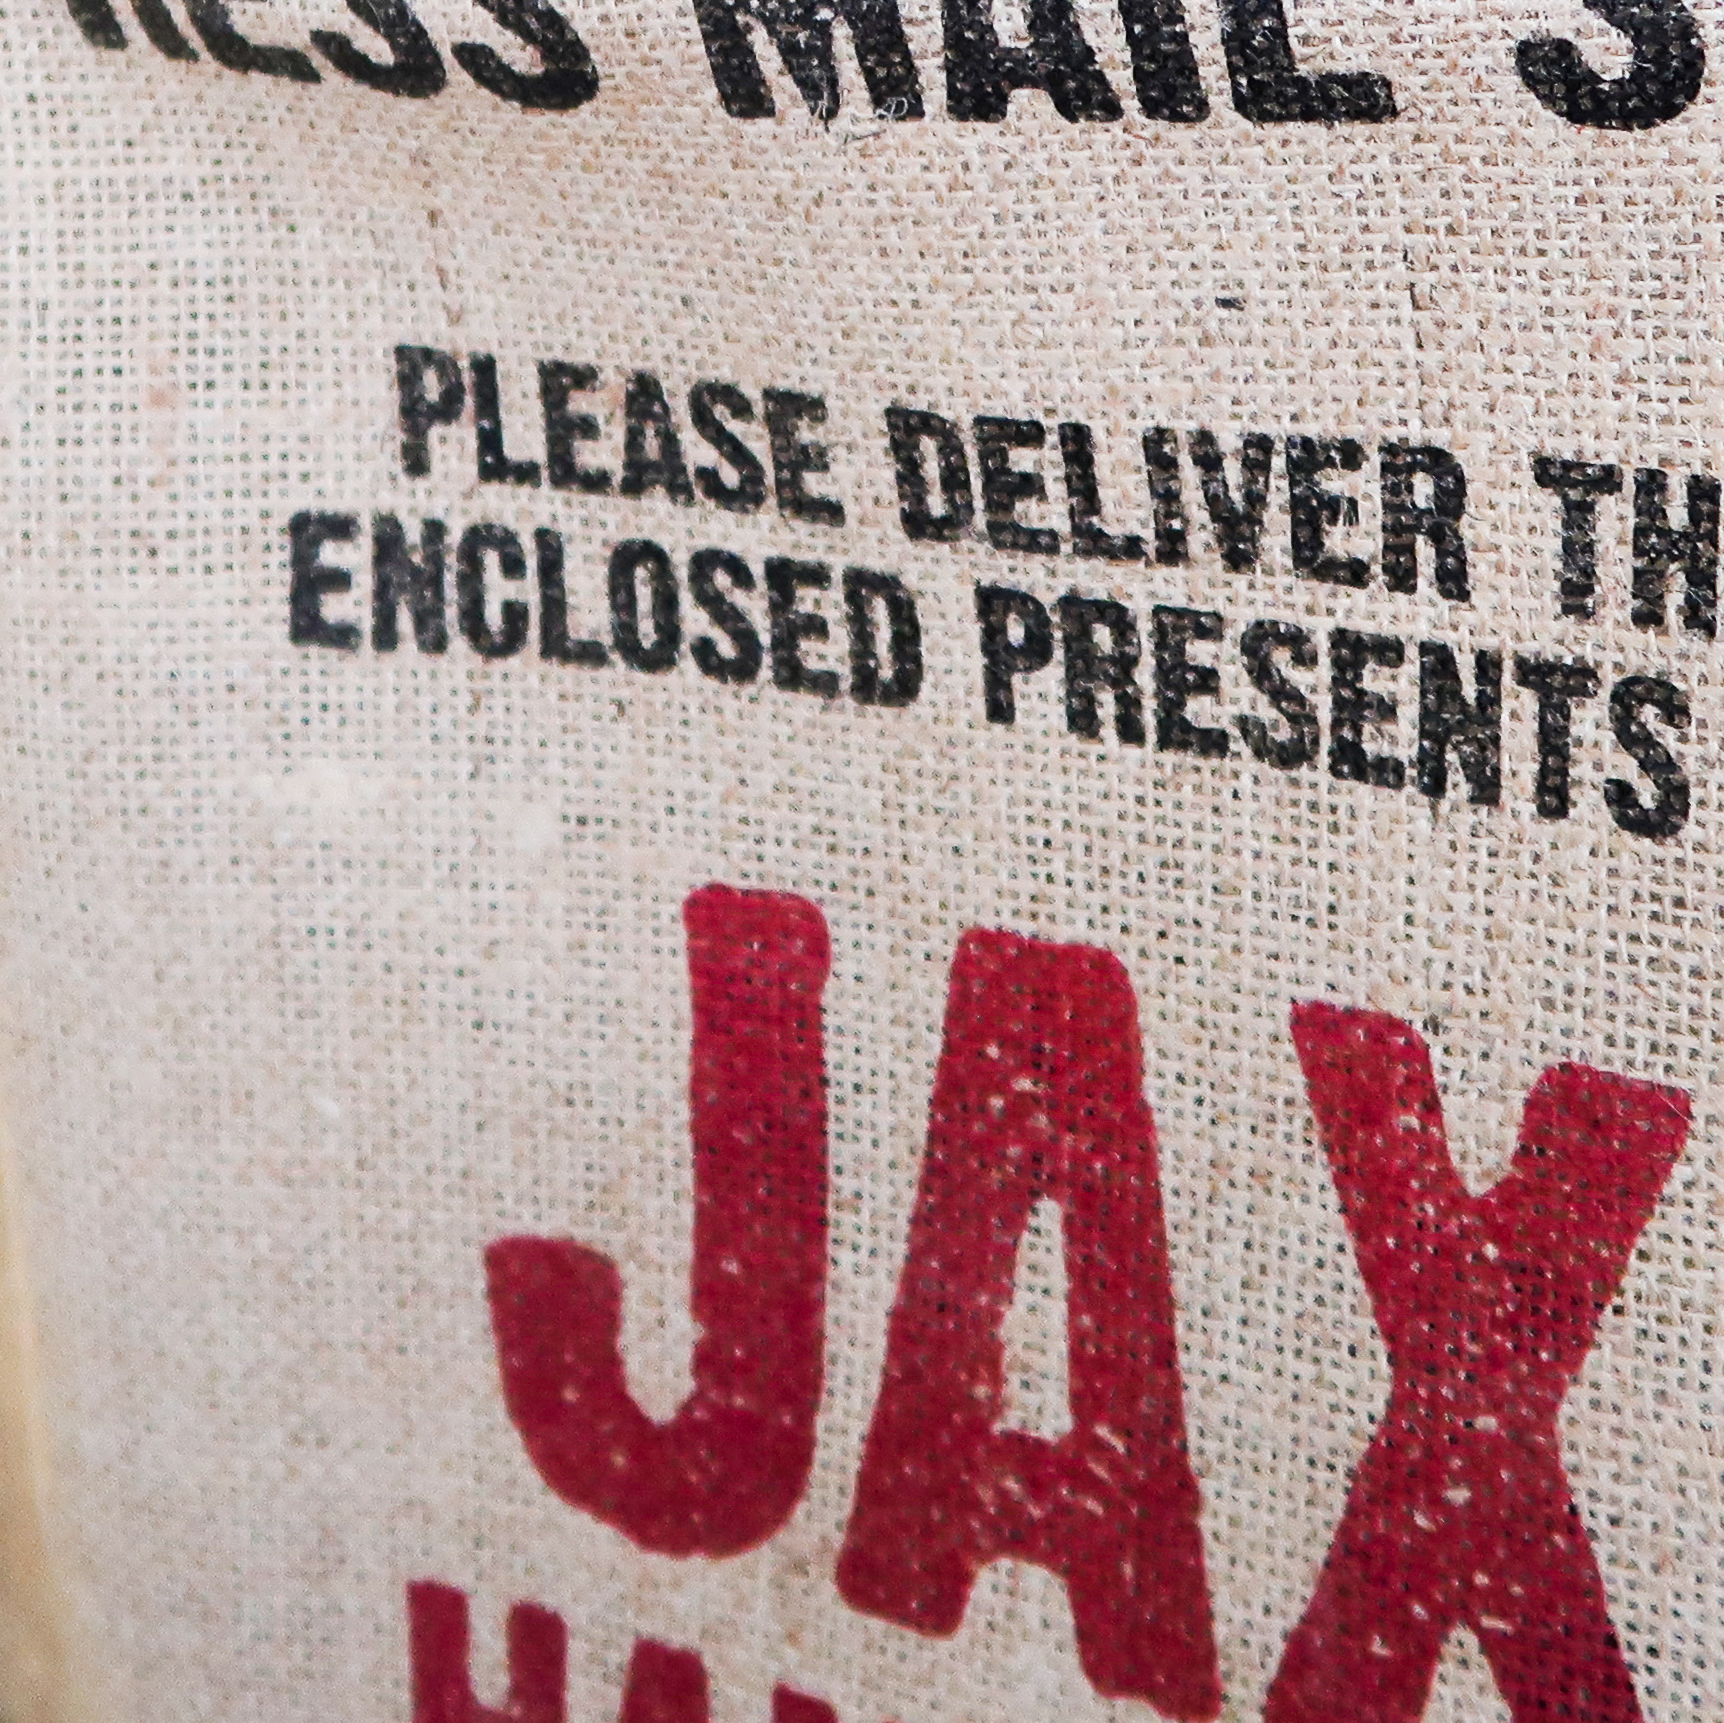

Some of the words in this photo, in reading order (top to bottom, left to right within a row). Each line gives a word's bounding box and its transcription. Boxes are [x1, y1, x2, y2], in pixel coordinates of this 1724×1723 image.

[394, 345, 847, 527] PLEASE
[883, 403, 1472, 604] DELIVER
[287, 512, 925, 708] ENCLOSED
[973, 583, 1692, 842] PRESENTS
[486, 883, 1691, 1723] JAX
